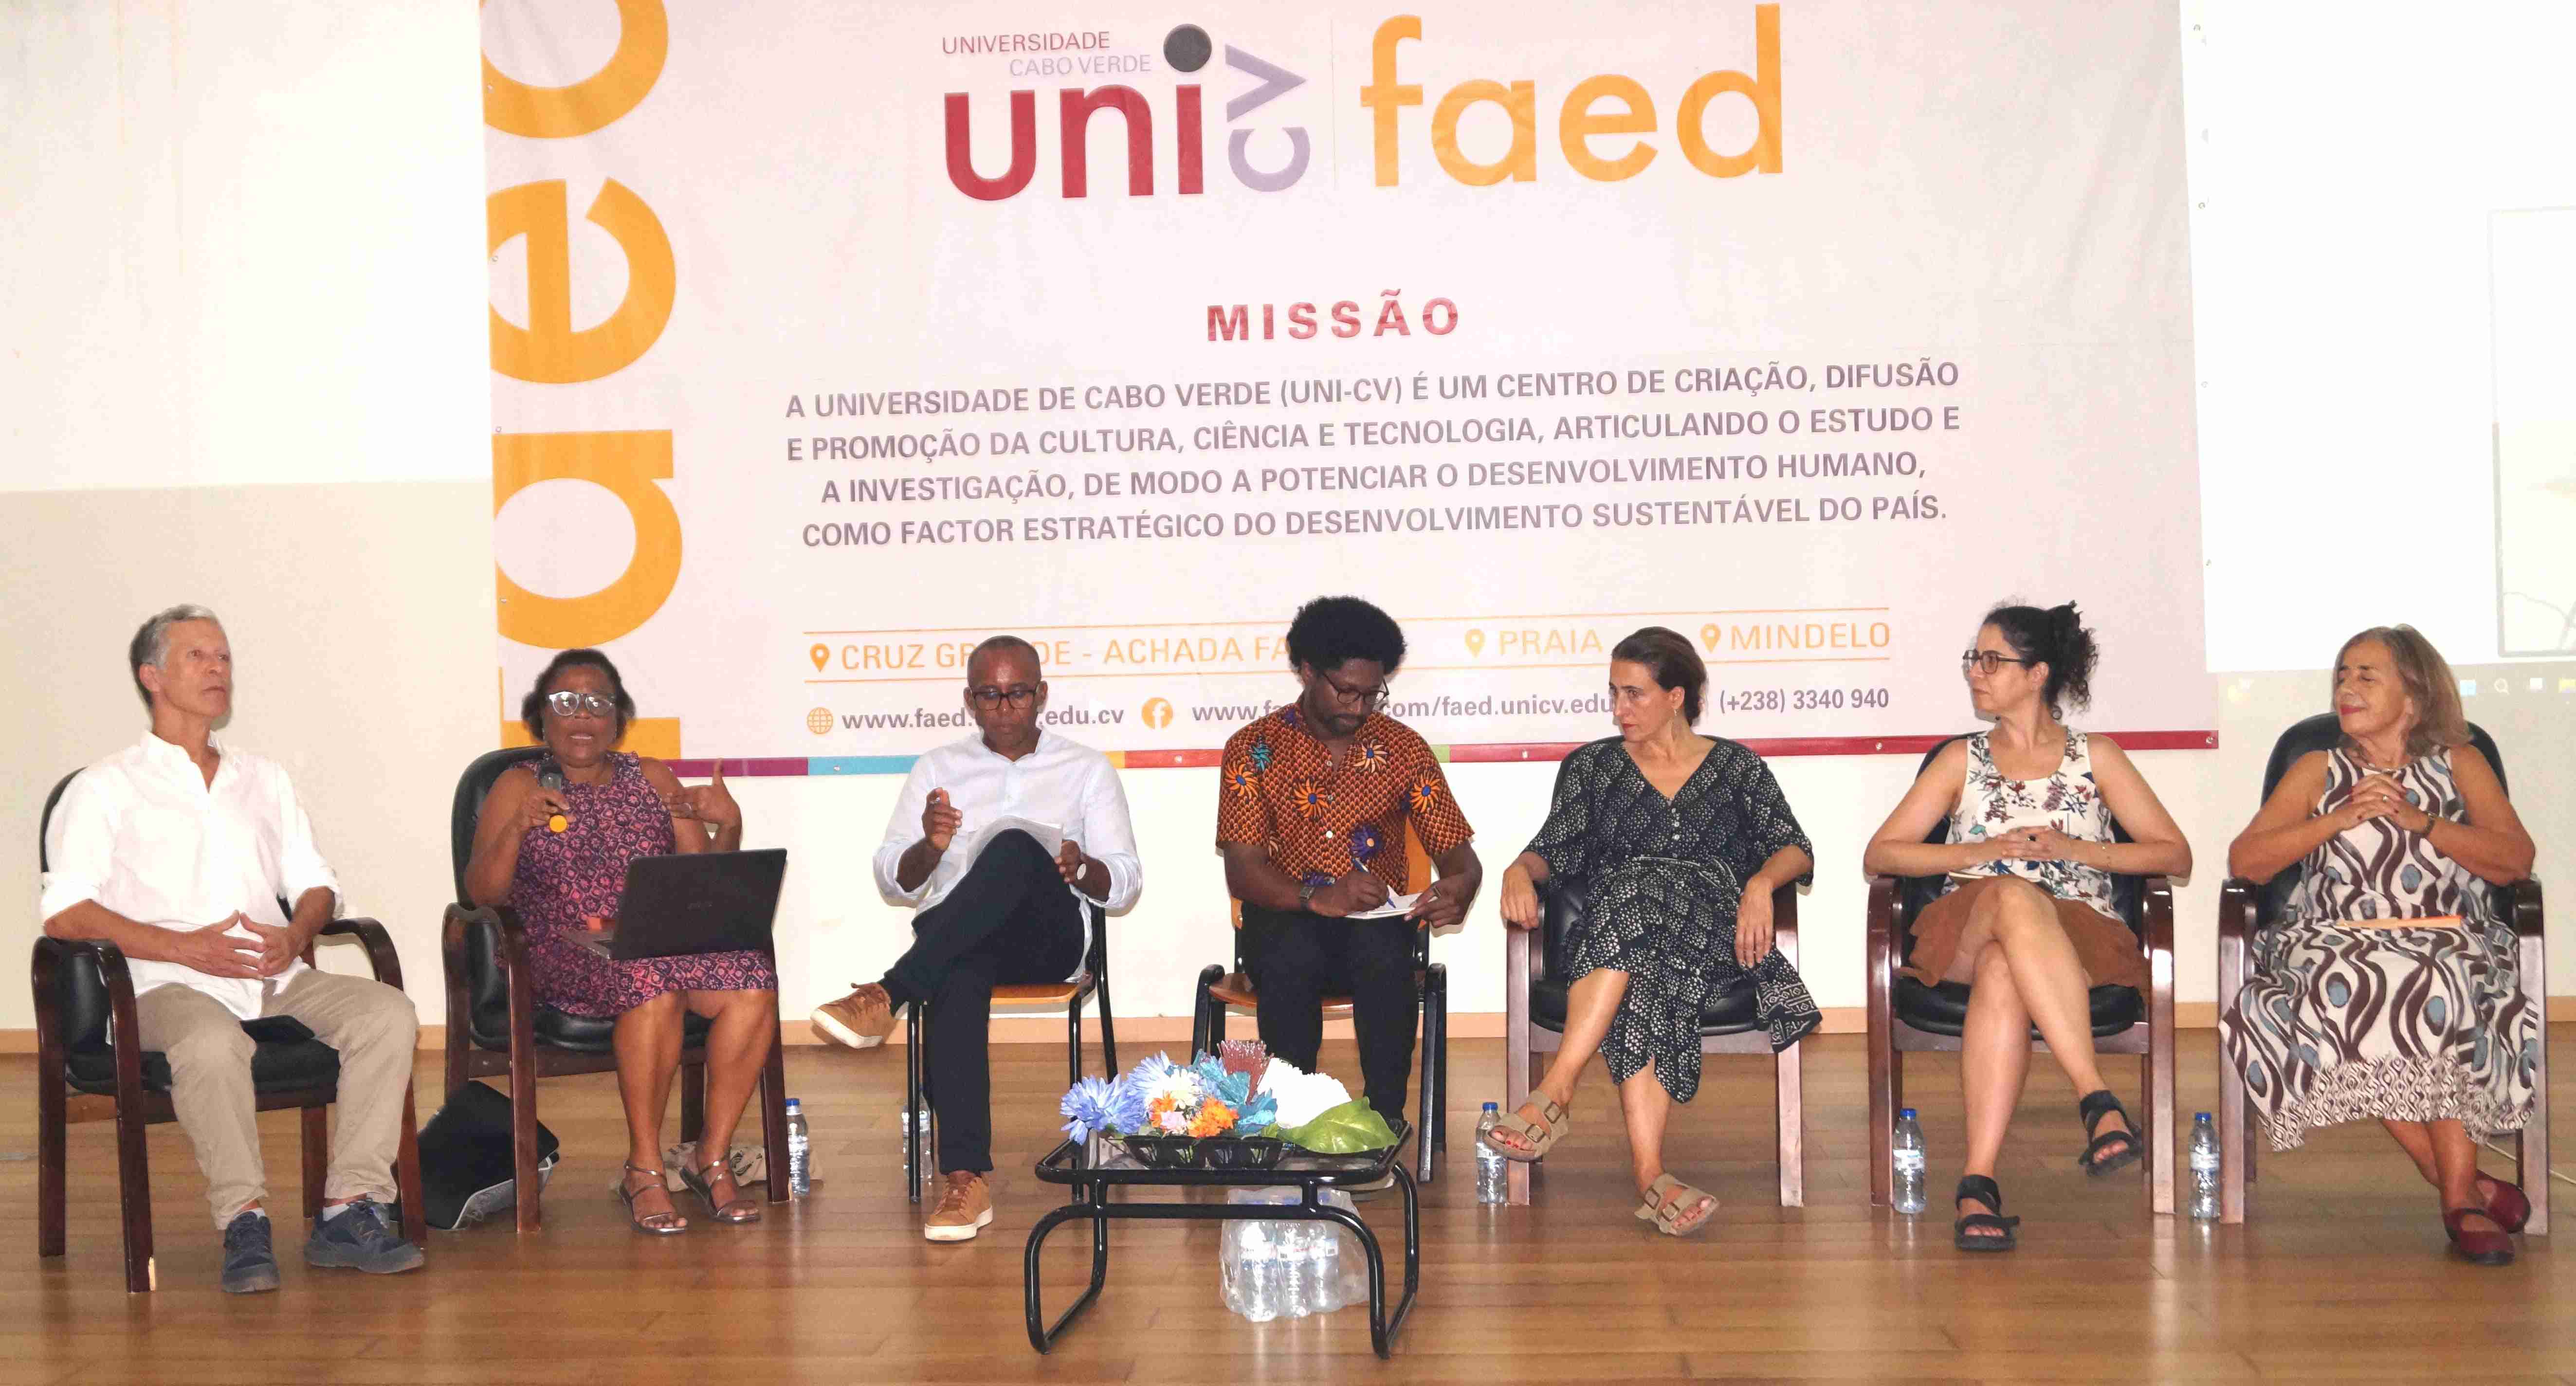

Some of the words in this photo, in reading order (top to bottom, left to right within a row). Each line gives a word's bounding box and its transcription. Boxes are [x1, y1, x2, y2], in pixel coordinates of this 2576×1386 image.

[942, 31, 1110, 55] UNIVERSIDADE
[1009, 56, 1074, 77] CABO
[1078, 54, 1151, 75] VERDE
[1360, 4, 1783, 187] faed
[1207, 289, 1458, 341] MISSÃO
[786, 395, 805, 418] A
[815, 388, 1029, 418] UNIVERSIDADE
[1039, 386, 1076, 411] DE
[1084, 384, 1166, 410] CABO
[1174, 381, 1271, 407] VERDE
[1280, 376, 1402, 408] (UNI-CV)
[1413, 370, 1428, 400] É
[1439, 375, 1487, 400] UM
[1497, 370, 1617, 398] CENTRO
[1627, 369, 1665, 394] DE
[1675, 361, 1816, 397] CRIAÇÃO,
[1826, 357, 1959, 388] DIFUSÃO
[787, 438, 803, 461] E
[812, 428, 980, 464] PROMOÇÃO
[990, 431, 1030, 456] DA
[1039, 427, 1184, 455] CULTURA,
[1193, 420, 1309, 450] CIÊNCIA
[1319, 423, 1335, 447] E
[1343, 418, 1544, 446] TECNOLOGIA,
[1553, 410, 1769, 440] ARTICULANDO
[1778, 410, 1800, 434] O
[1810, 406, 1933, 433] ESTUDO
[1943, 406, 1960, 430] E
[821, 480, 840, 503] A
[850, 470, 1074, 505] INVESTIGAÇÃO,
[1084, 473, 1121, 496] DE
[1131, 470, 1223, 495] MODO
[1231, 469, 1252, 492] A
[1261, 464, 1427, 492] POTENCIAR
[1437, 463, 1458, 488] O
[1468, 455, 1768, 486] DESENVOLVIMENTO
[1778, 451, 1925, 478] HUMANO,
[803, 521, 891, 547] COMO
[901, 519, 1014, 545] FACTOR
[1023, 509, 1224, 541] ESTRATÉGICO
[1234, 511, 1276, 536] DO
[1286, 504, 1583, 535] DESENVOLVIMENTO
[1593, 493, 1810, 527] SUSTENTÁVEL
[1819, 496, 1862, 521] DO
[1872, 489, 1946, 520] PAÍS.
[841, 644, 925, 671] CRUZ
[1103, 637, 1245, 664] ACHADA
[1499, 628, 1604, 655] PRAIA
[1731, 622, 1891, 651] MINDELO
[1719, 688, 1785, 714] (+238)
[1793, 689, 1844, 710] 3340
[1851, 688, 1889, 709] 940
